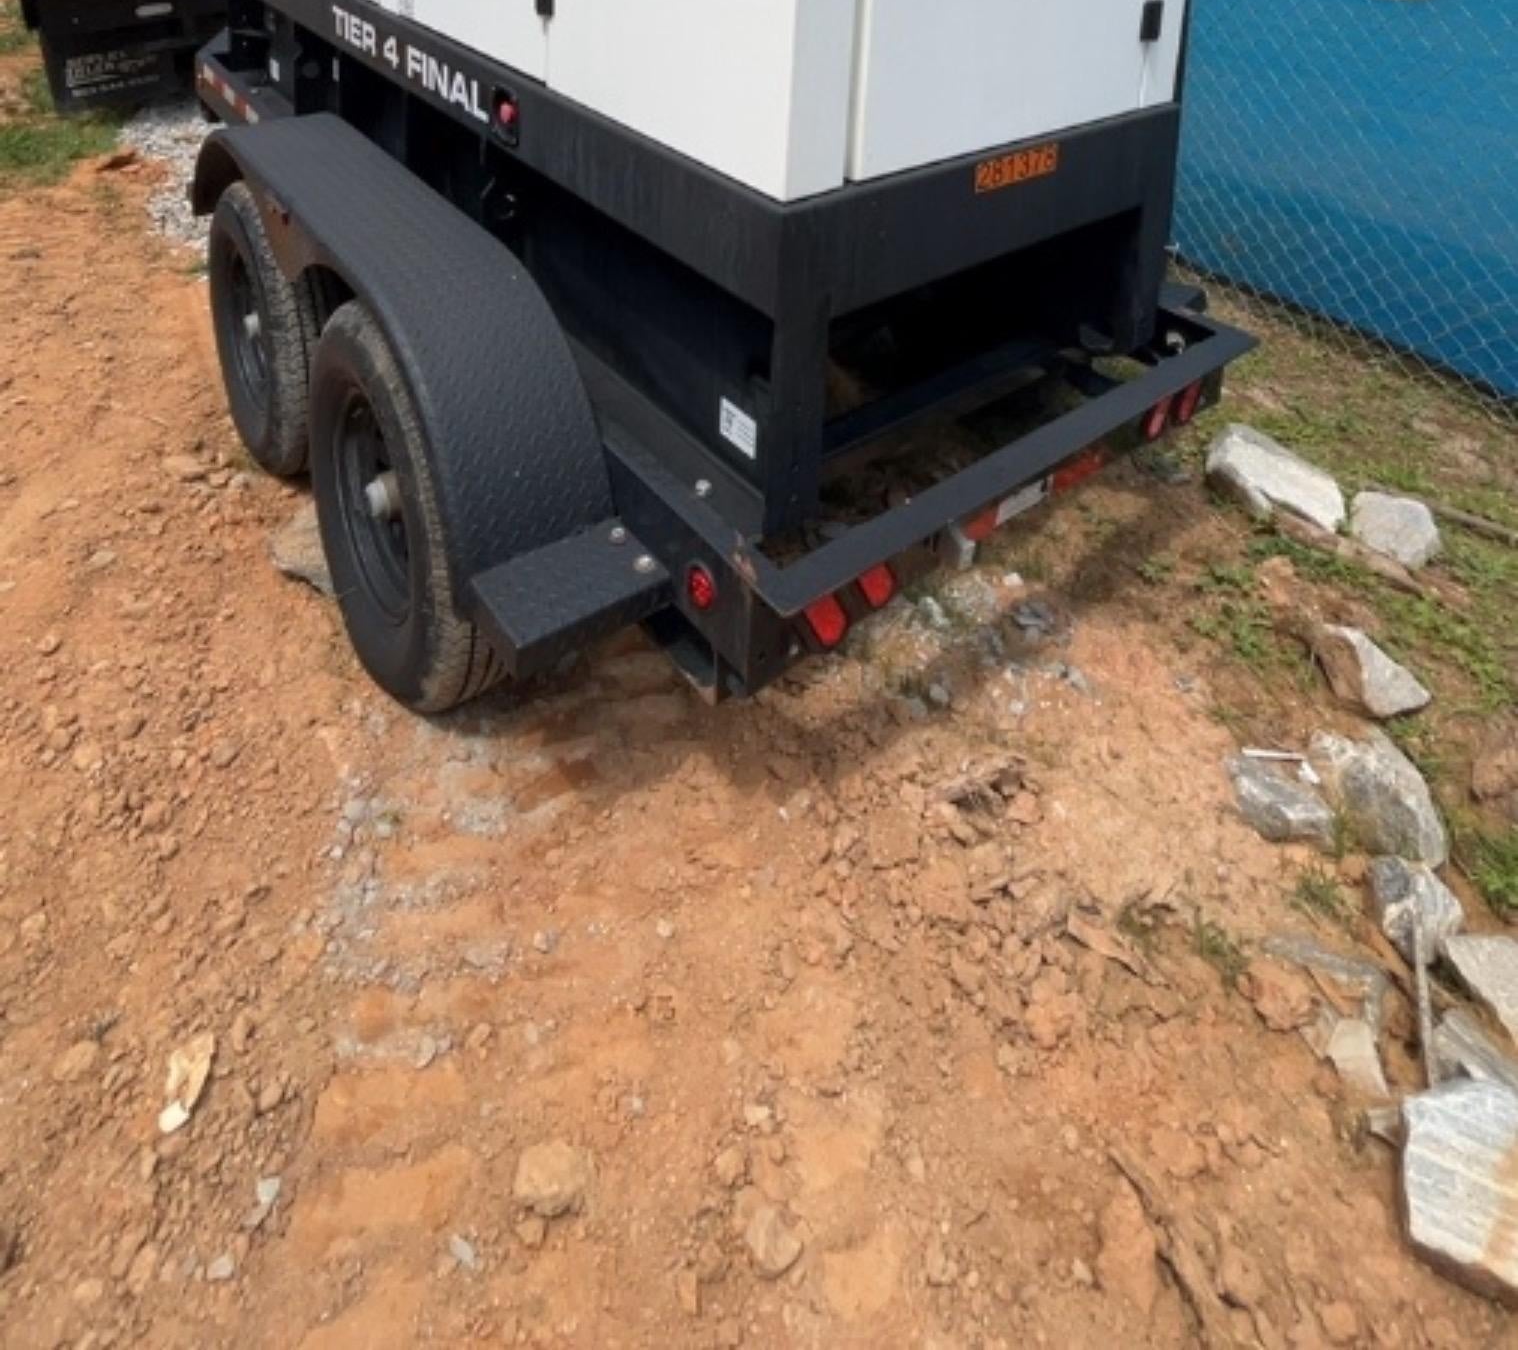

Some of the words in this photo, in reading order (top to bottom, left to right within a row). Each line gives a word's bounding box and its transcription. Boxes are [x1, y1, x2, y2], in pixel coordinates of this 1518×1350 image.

[332, 4, 377, 58] TIER
[383, 35, 400, 70] 4
[406, 45, 489, 124] FINAL
